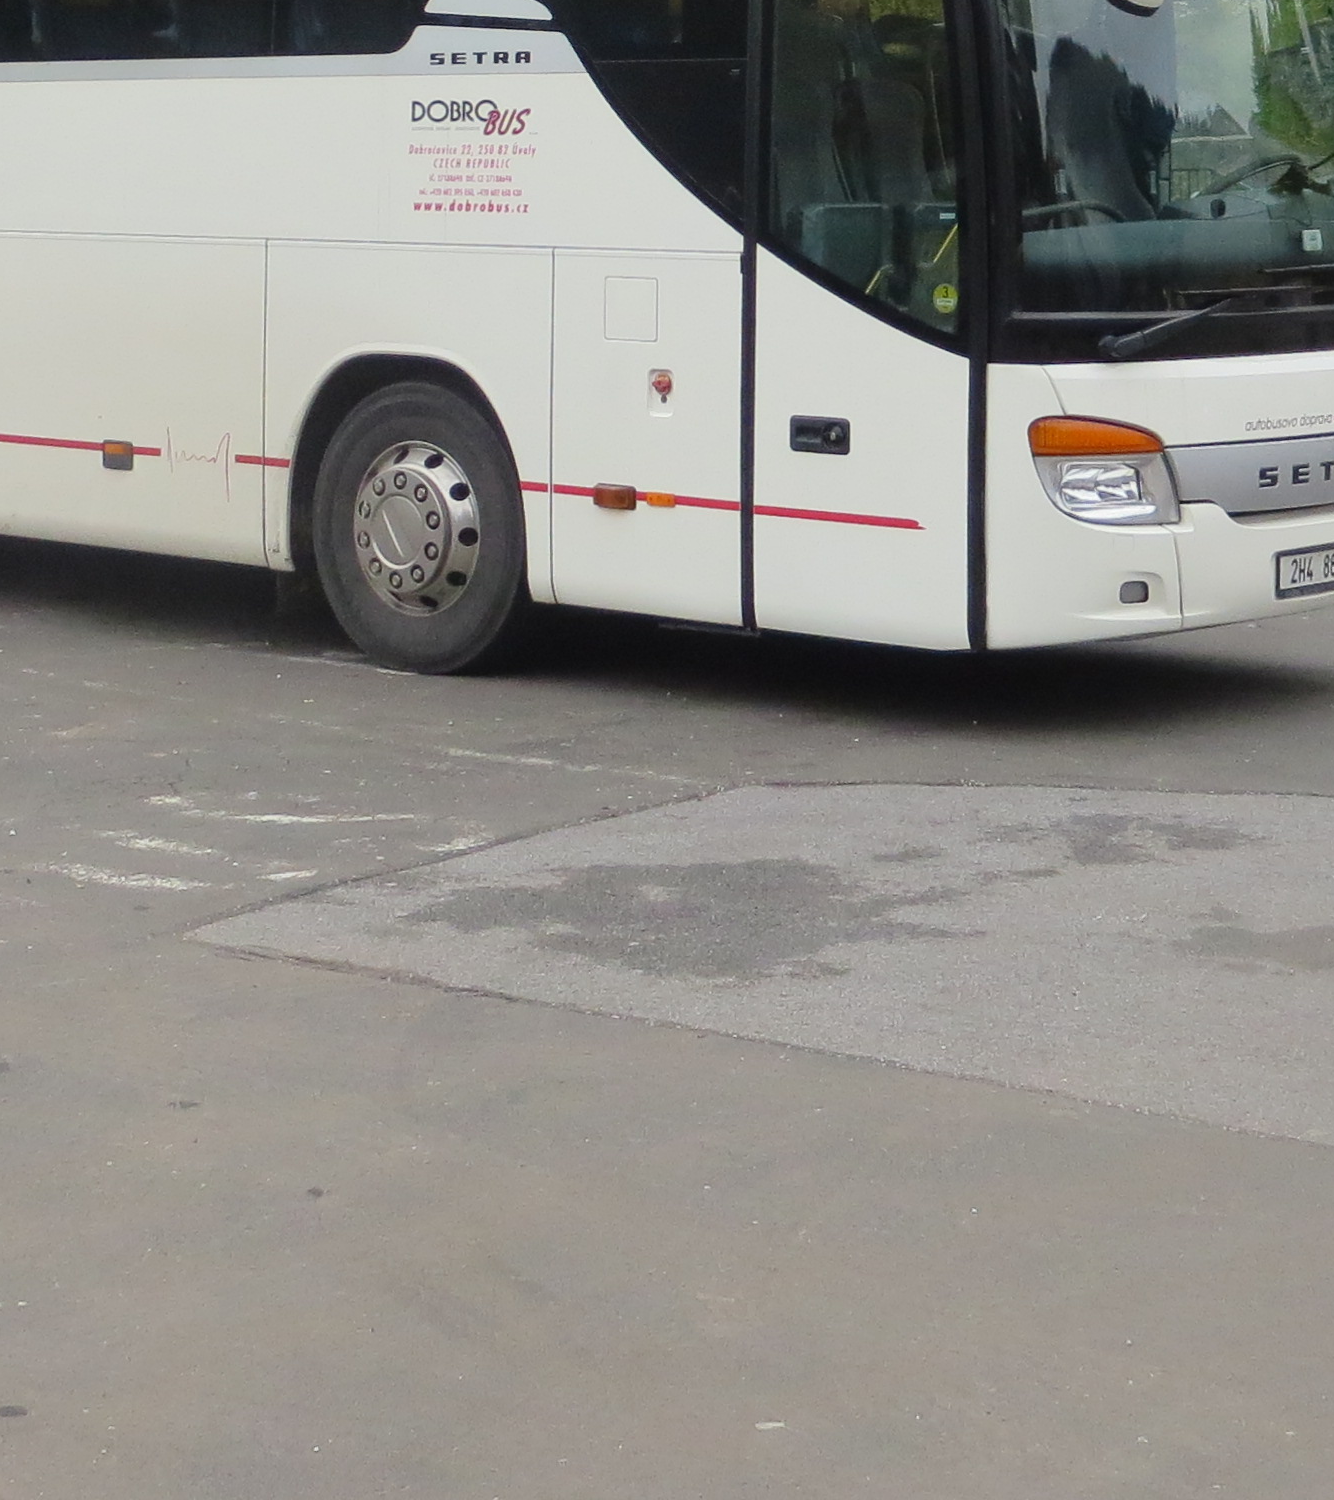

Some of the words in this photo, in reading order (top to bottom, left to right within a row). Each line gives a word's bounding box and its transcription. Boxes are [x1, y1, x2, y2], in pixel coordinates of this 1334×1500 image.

[429, 50, 532, 66] SETRA
[478, 143, 495, 156] 250
[432, 157, 462, 169] CZECH
[465, 157, 511, 169] REPUBLIC
[413, 199, 530, 214] www.dobrobus.cz
[941, 285, 949, 299] 3
[1290, 556, 1314, 584] 2H4
